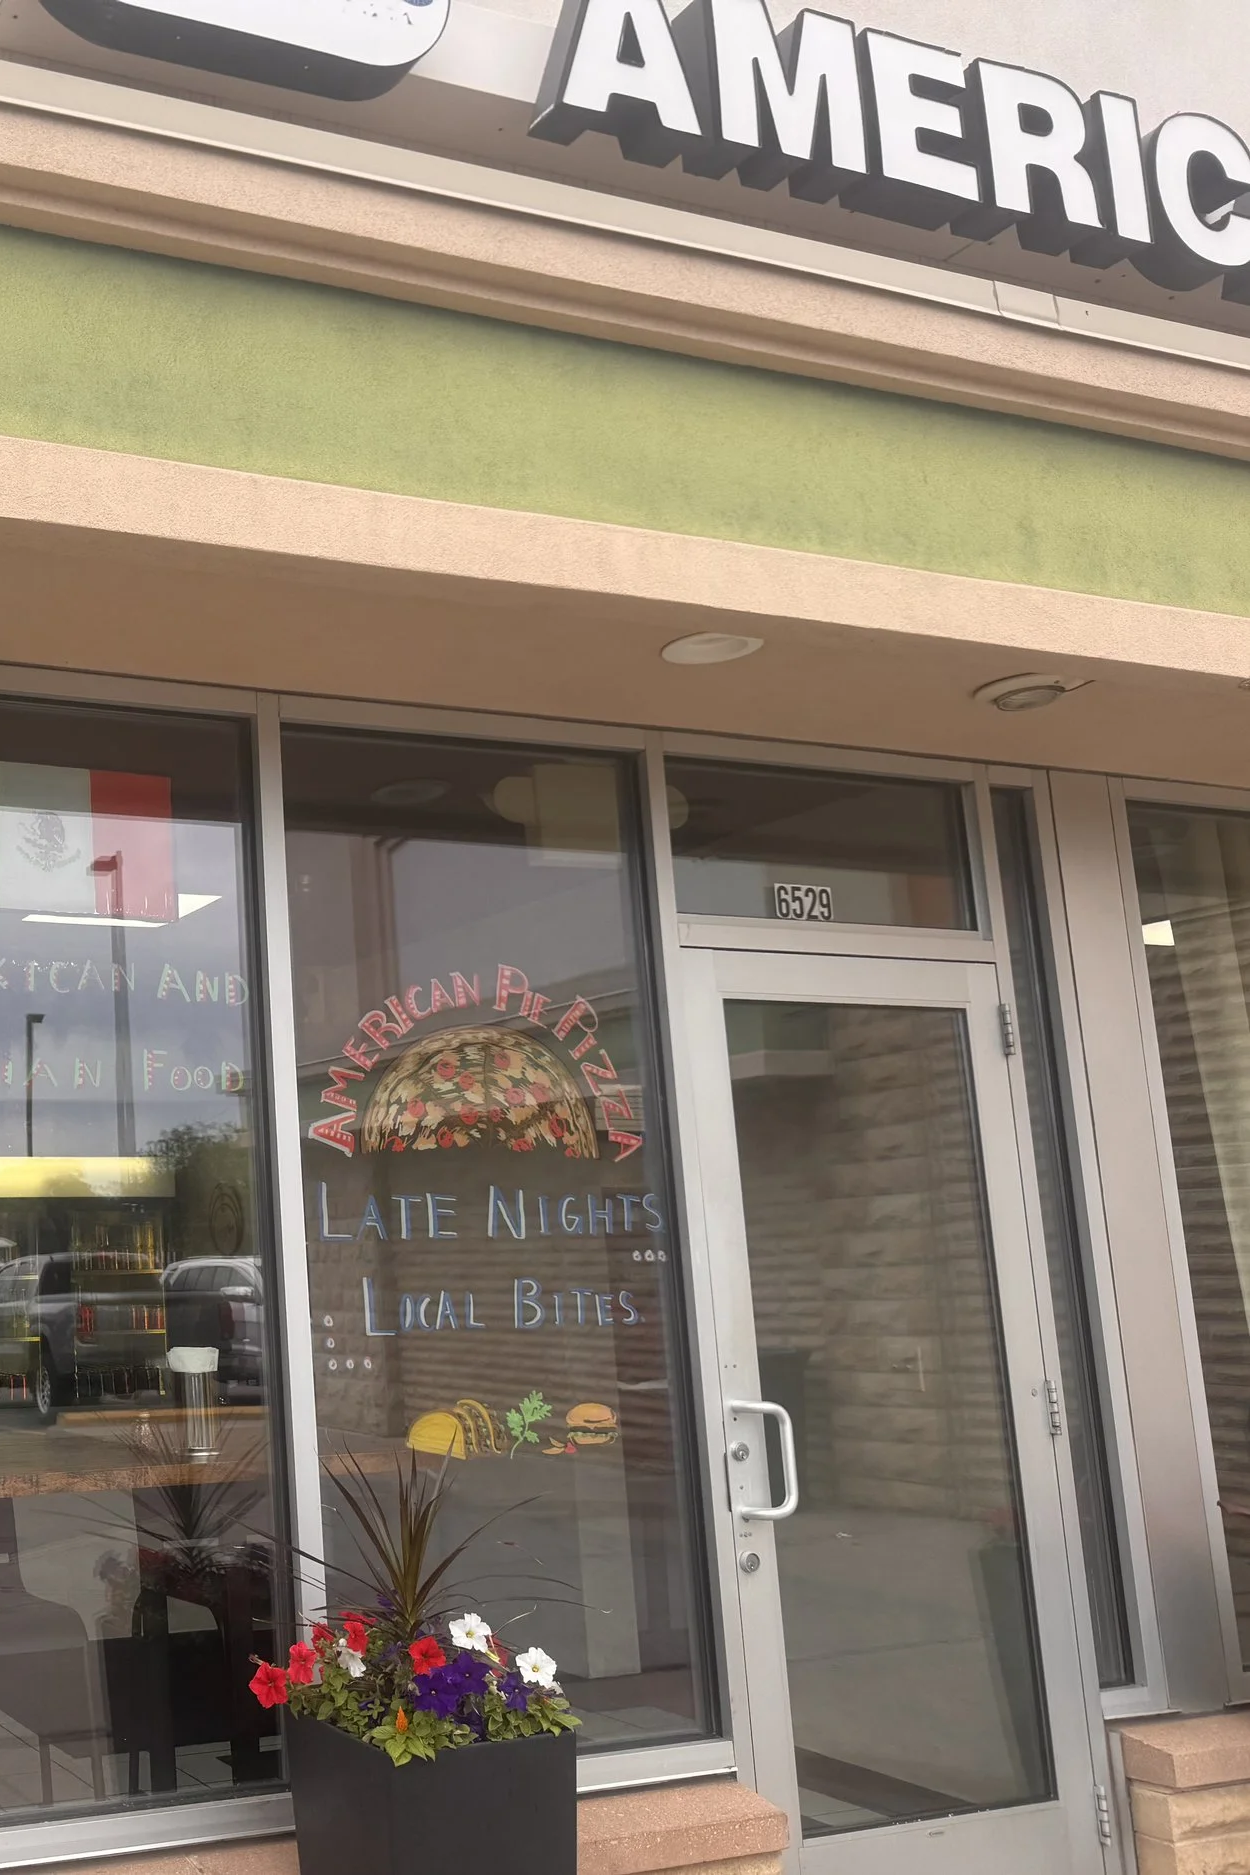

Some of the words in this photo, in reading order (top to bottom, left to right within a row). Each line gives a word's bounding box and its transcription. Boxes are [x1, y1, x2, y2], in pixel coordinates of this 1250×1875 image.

[776, 885, 832, 921] 6529
[157, 963, 250, 1007] AND
[143, 1048, 246, 1093] FOOD
[308, 970, 481, 1158] AMERICAN
[493, 963, 552, 1029] PIE
[551, 995, 643, 1163] PIZZA
[318, 1181, 459, 1242] LATE
[487, 1185, 667, 1241] NIGHTS
[361, 1276, 487, 1337] LOCAL
